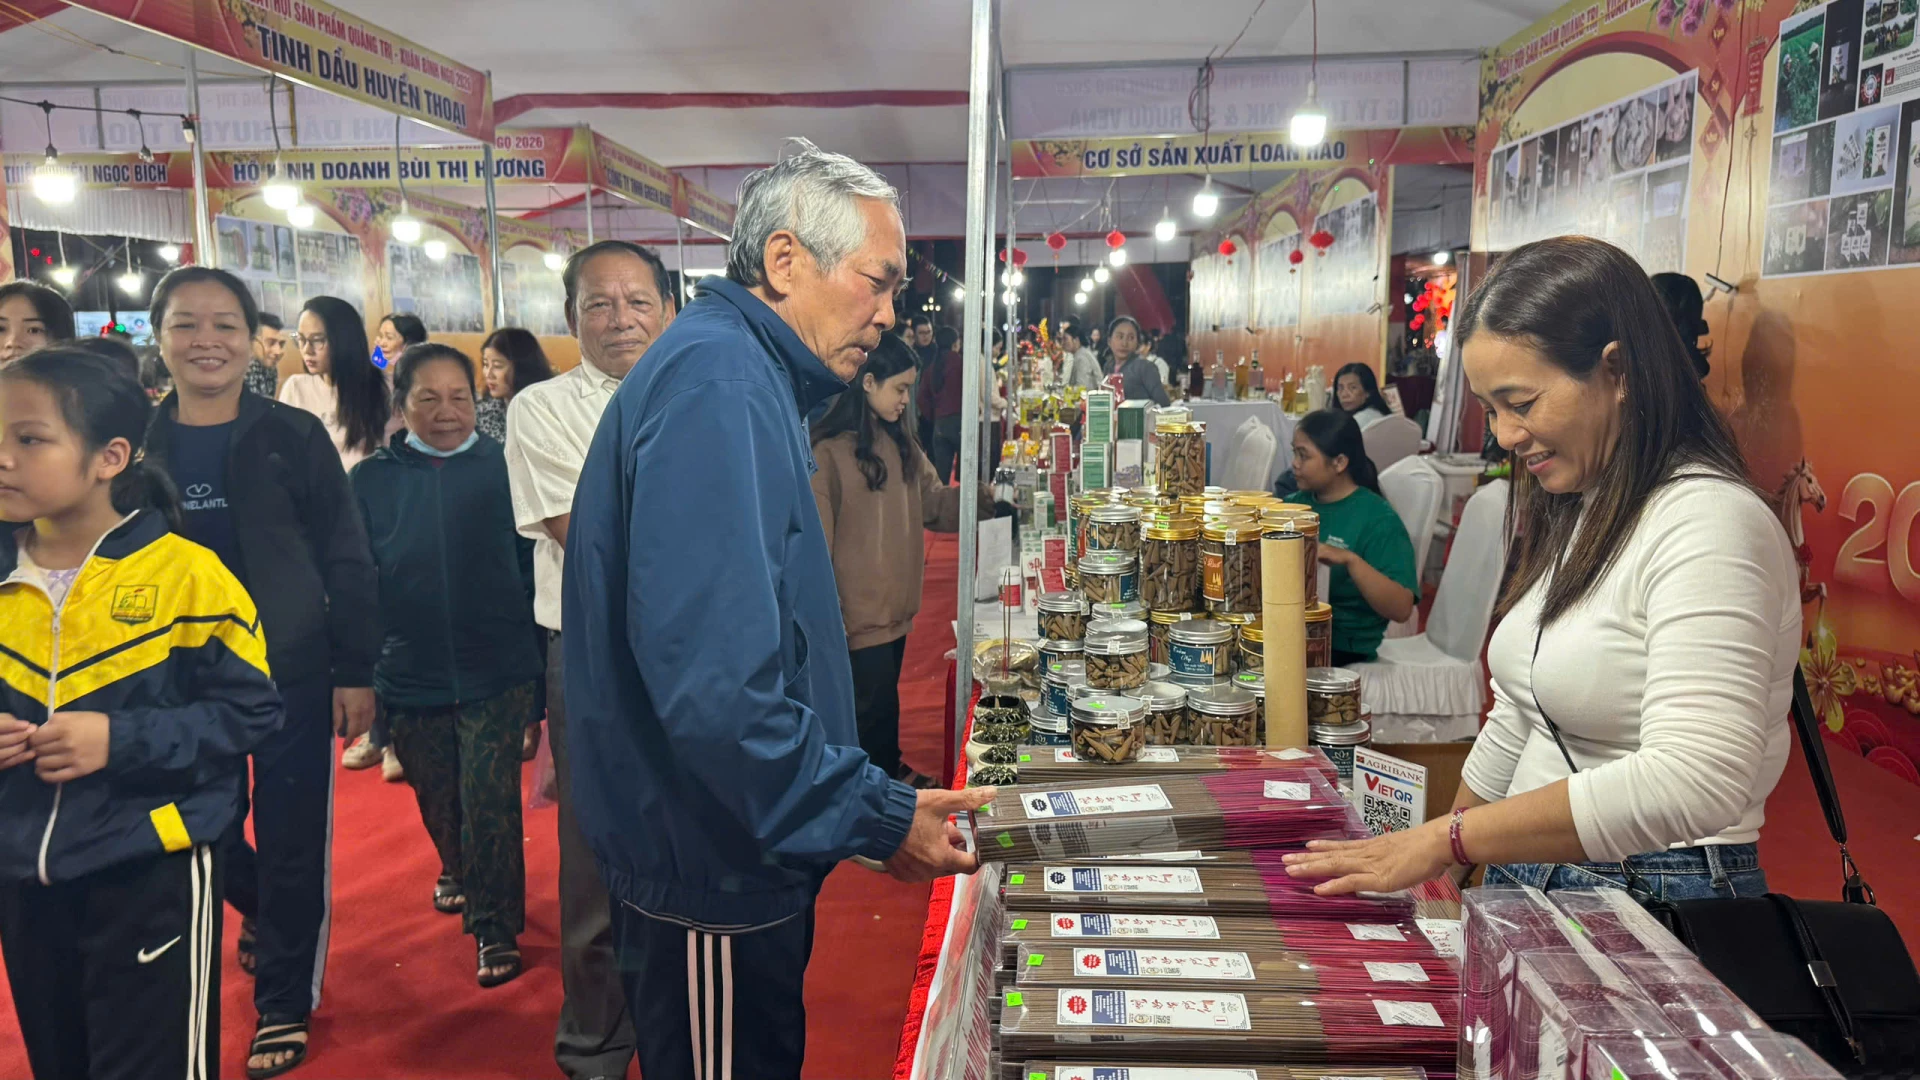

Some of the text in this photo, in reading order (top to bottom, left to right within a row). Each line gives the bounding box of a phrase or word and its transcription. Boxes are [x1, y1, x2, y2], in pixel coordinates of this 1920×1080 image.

[257, 25, 311, 73] TINH
[423, 89, 467, 129] THOẠI
[515, 136, 543, 149] 2026
[1084, 146, 1111, 169] CƠ
[1116, 143, 1143, 167] SỞ
[1148, 141, 1189, 167] SẢN
[1194, 138, 1244, 165] XUẤT
[1250, 148, 1299, 163] LOAN
[93, 163, 130, 188] NGỌC
[134, 162, 167, 183] BÍCH
[233, 160, 260, 184] HỘ
[267, 162, 315, 181] KNH
[321, 161, 390, 181] DOANH
[399, 156, 430, 179] BÙI
[437, 160, 468, 183] THỊ
[1367, 759, 1423, 783] AGRIBANK
[1364, 772, 1413, 805] VIETQR
